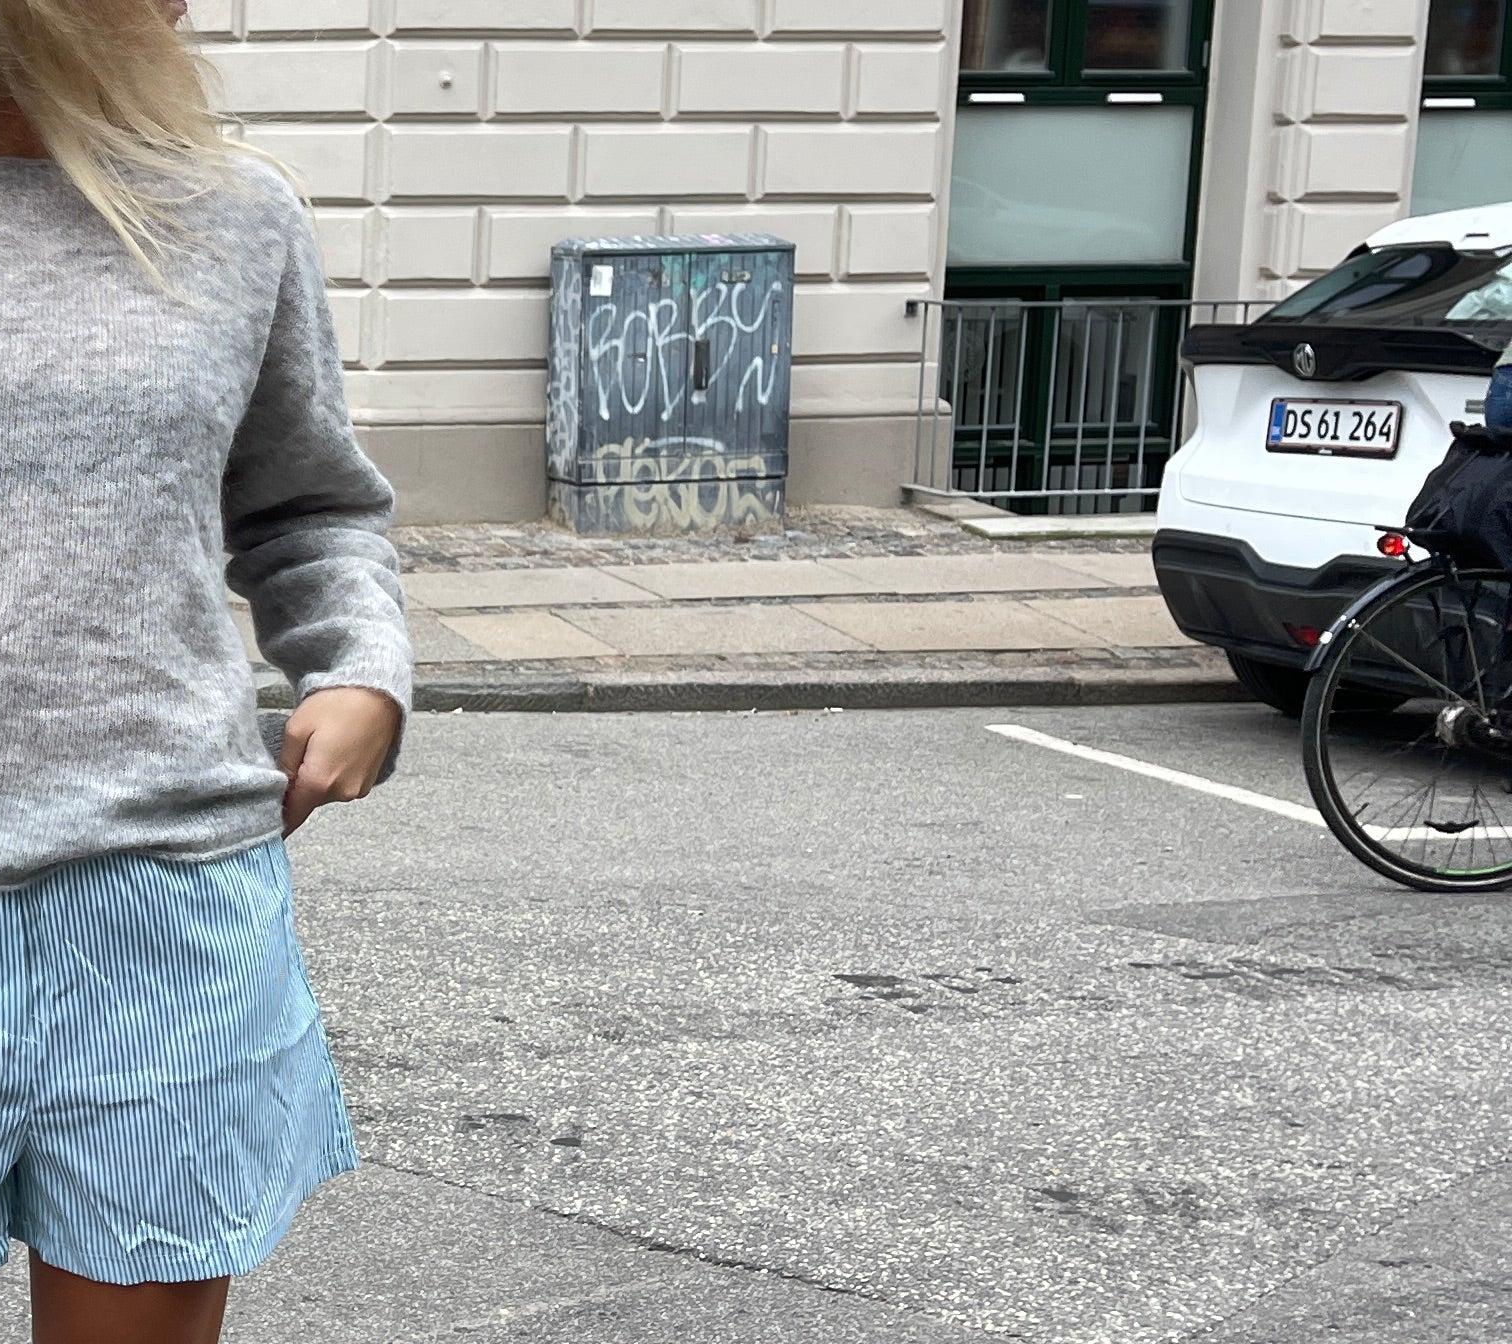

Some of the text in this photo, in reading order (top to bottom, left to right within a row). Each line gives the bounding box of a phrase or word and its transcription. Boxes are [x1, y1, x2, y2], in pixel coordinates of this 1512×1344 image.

[1284, 408, 1393, 442] DS 61 264
